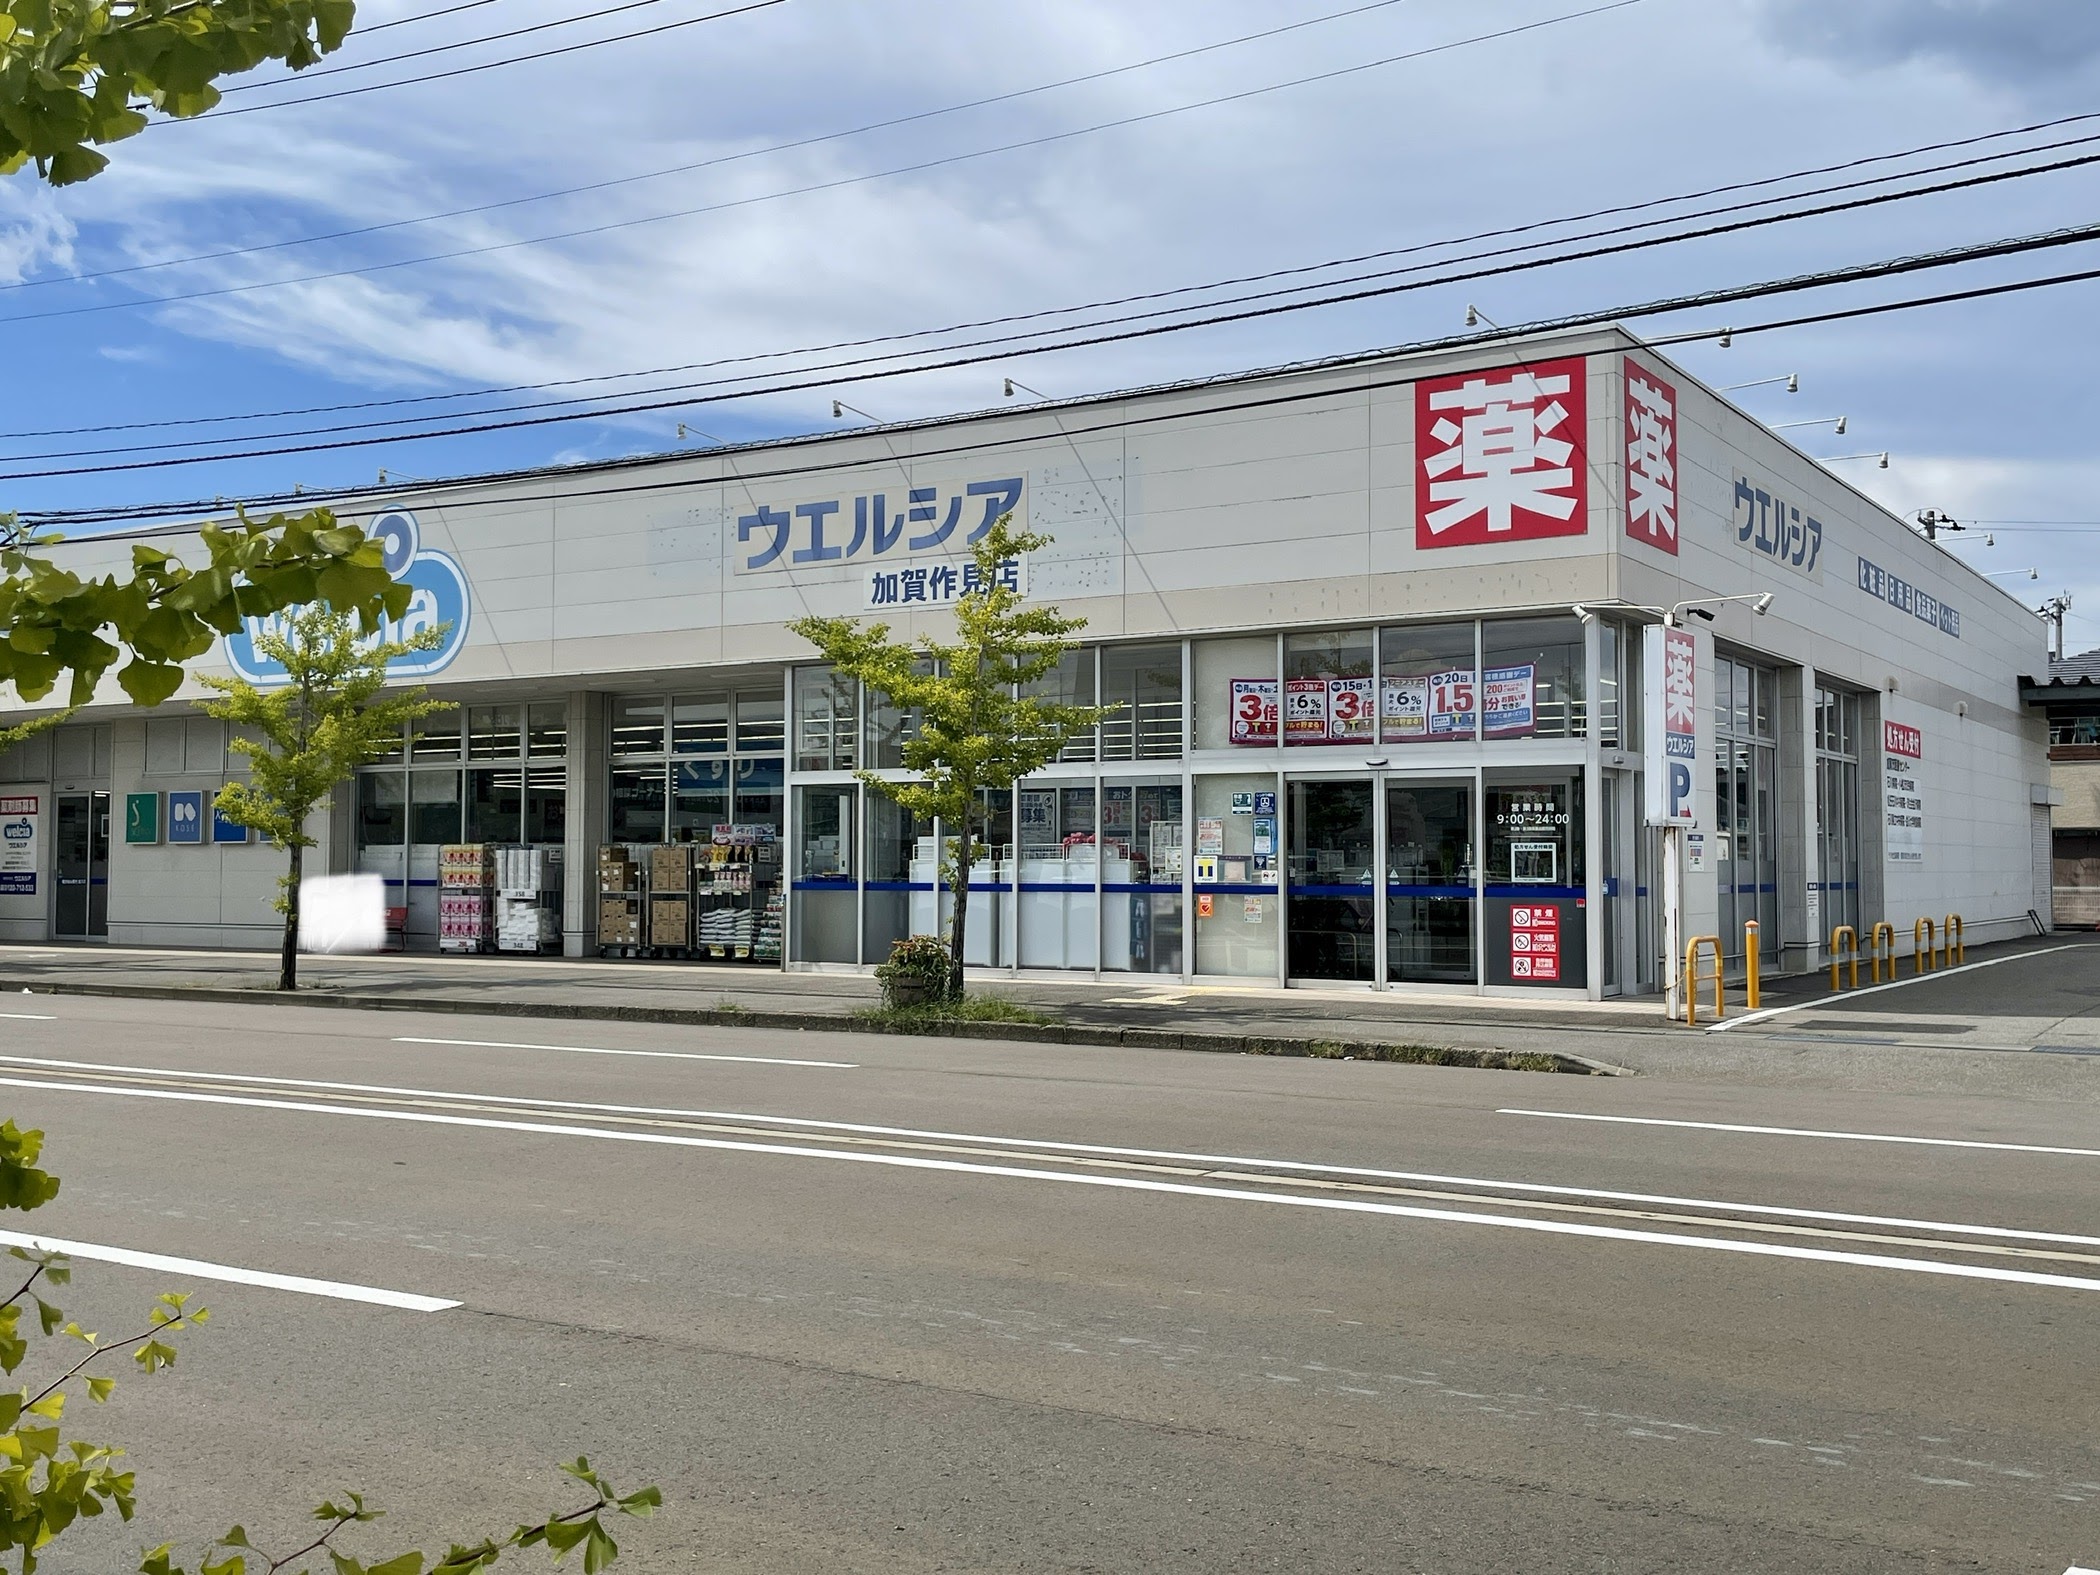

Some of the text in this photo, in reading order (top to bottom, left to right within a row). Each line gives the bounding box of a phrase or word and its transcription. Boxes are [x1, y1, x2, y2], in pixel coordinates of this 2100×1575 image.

[1423, 372, 1578, 535] 薬
[1628, 377, 1675, 540] 薬
[738, 478, 1022, 569] ウエルシア
[1734, 476, 1822, 572] ウエルシア
[871, 560, 1019, 604] 加賀作見店
[1860, 560, 1885, 597] 化粧品
[1889, 577, 1912, 611] 日用品
[1916, 592, 1936, 624] 食品菓子
[1445, 673, 1468, 683] 20日
[1487, 684, 1502, 694] 200
[1667, 639, 1694, 725] 薬
[1297, 694, 1321, 709] 6%
[1397, 691, 1421, 705] 6%
[1436, 684, 1473, 713] 1.5
[1667, 736, 1694, 754] ウエルシア
[1670, 762, 1690, 817] P
[1511, 803, 1555, 812] 営業時間
